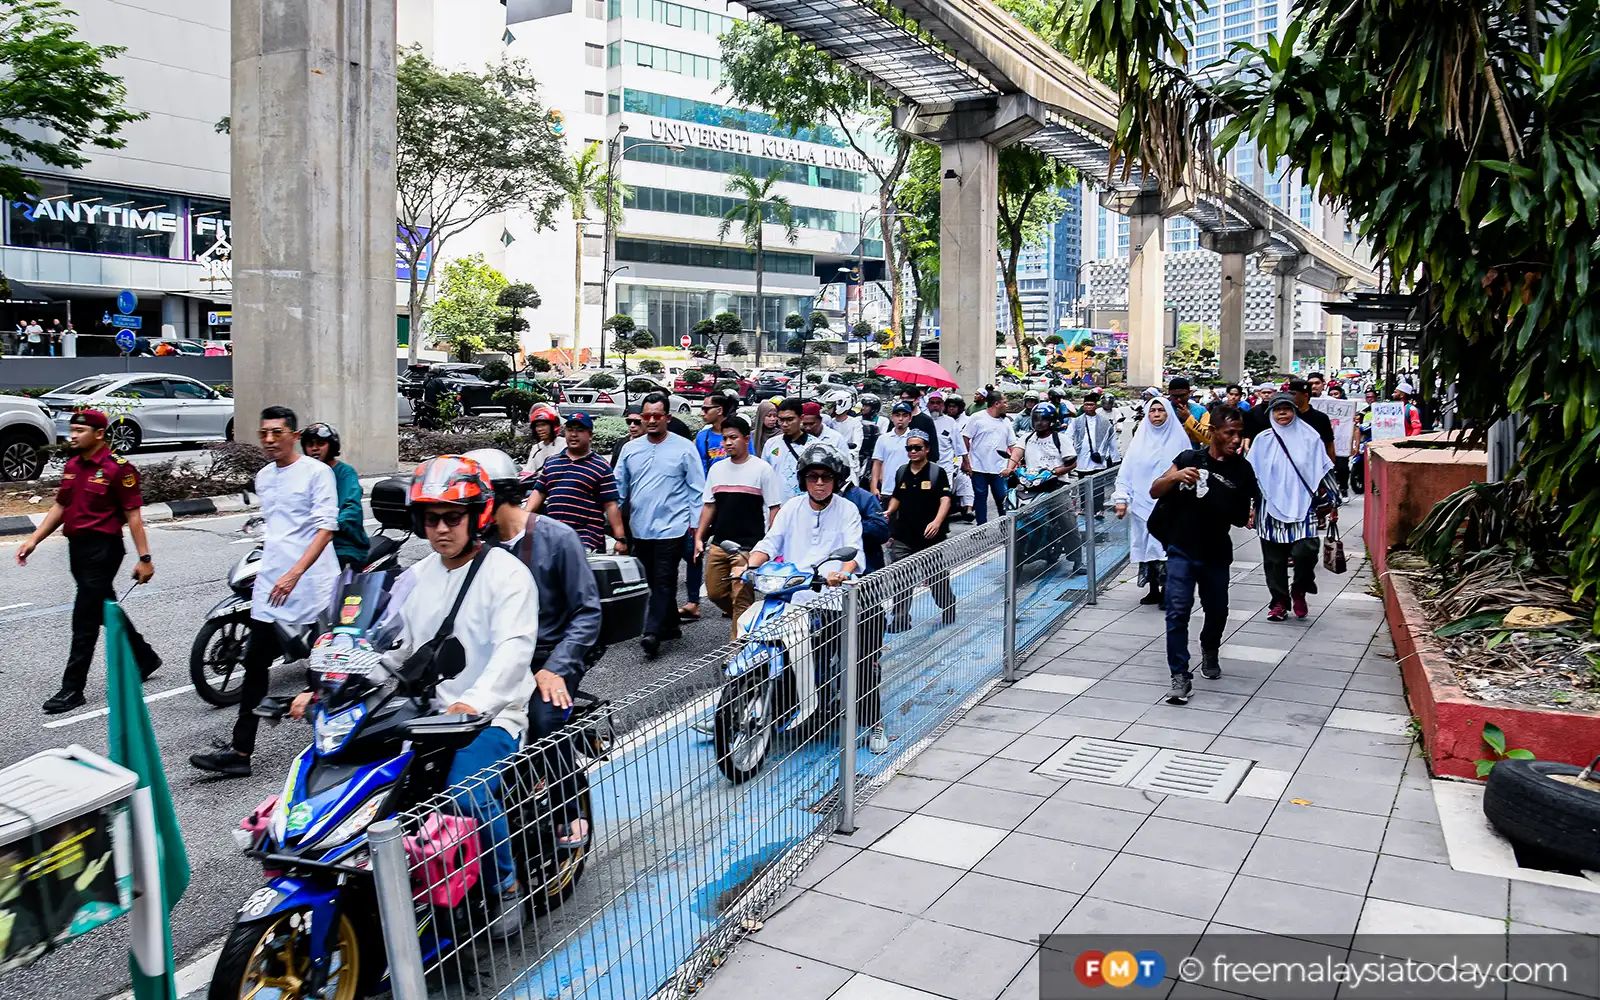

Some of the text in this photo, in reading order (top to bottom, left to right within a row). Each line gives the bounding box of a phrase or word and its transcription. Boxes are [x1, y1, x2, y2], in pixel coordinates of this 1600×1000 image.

[650, 119, 888, 174] UNIVERSITI KUALA LUMPUR
[32, 200, 177, 233] ANYTIME
